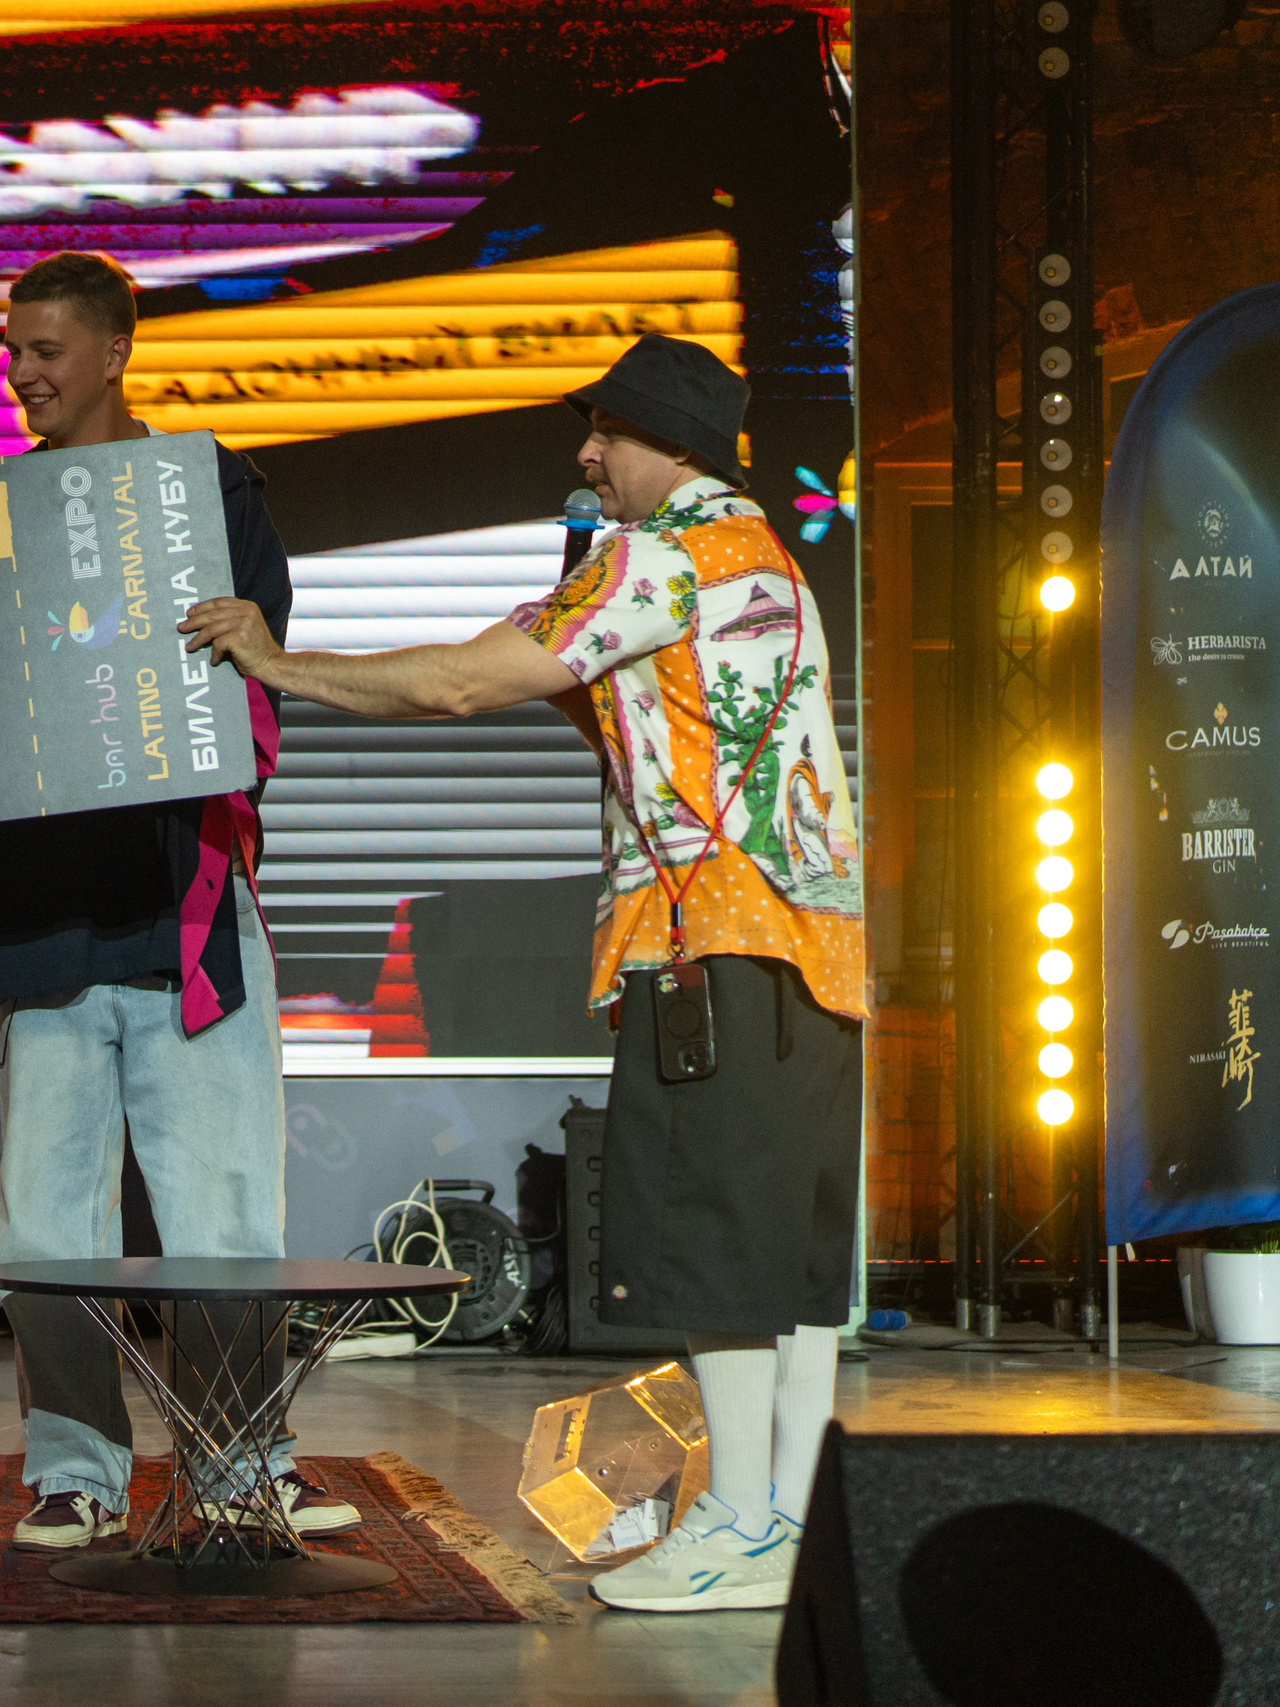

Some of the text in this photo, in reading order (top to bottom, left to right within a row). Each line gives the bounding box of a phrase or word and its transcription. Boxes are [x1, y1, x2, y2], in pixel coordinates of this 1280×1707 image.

[156, 460, 193, 554] КУБУ
[1169, 554, 1252, 580] АЛТАЙ
[170, 565, 200, 628] НА
[61, 466, 127, 789] bar hub EXPO
[111, 461, 169, 780] LATINO CARNAVAL
[1187, 635, 1267, 650] HERBARISTA
[1165, 726, 1261, 751] CAMUS
[1181, 828, 1256, 861] BARRISTER
[1212, 859, 1236, 874] GIN
[1189, 1051, 1226, 1064] NIRASAKI
